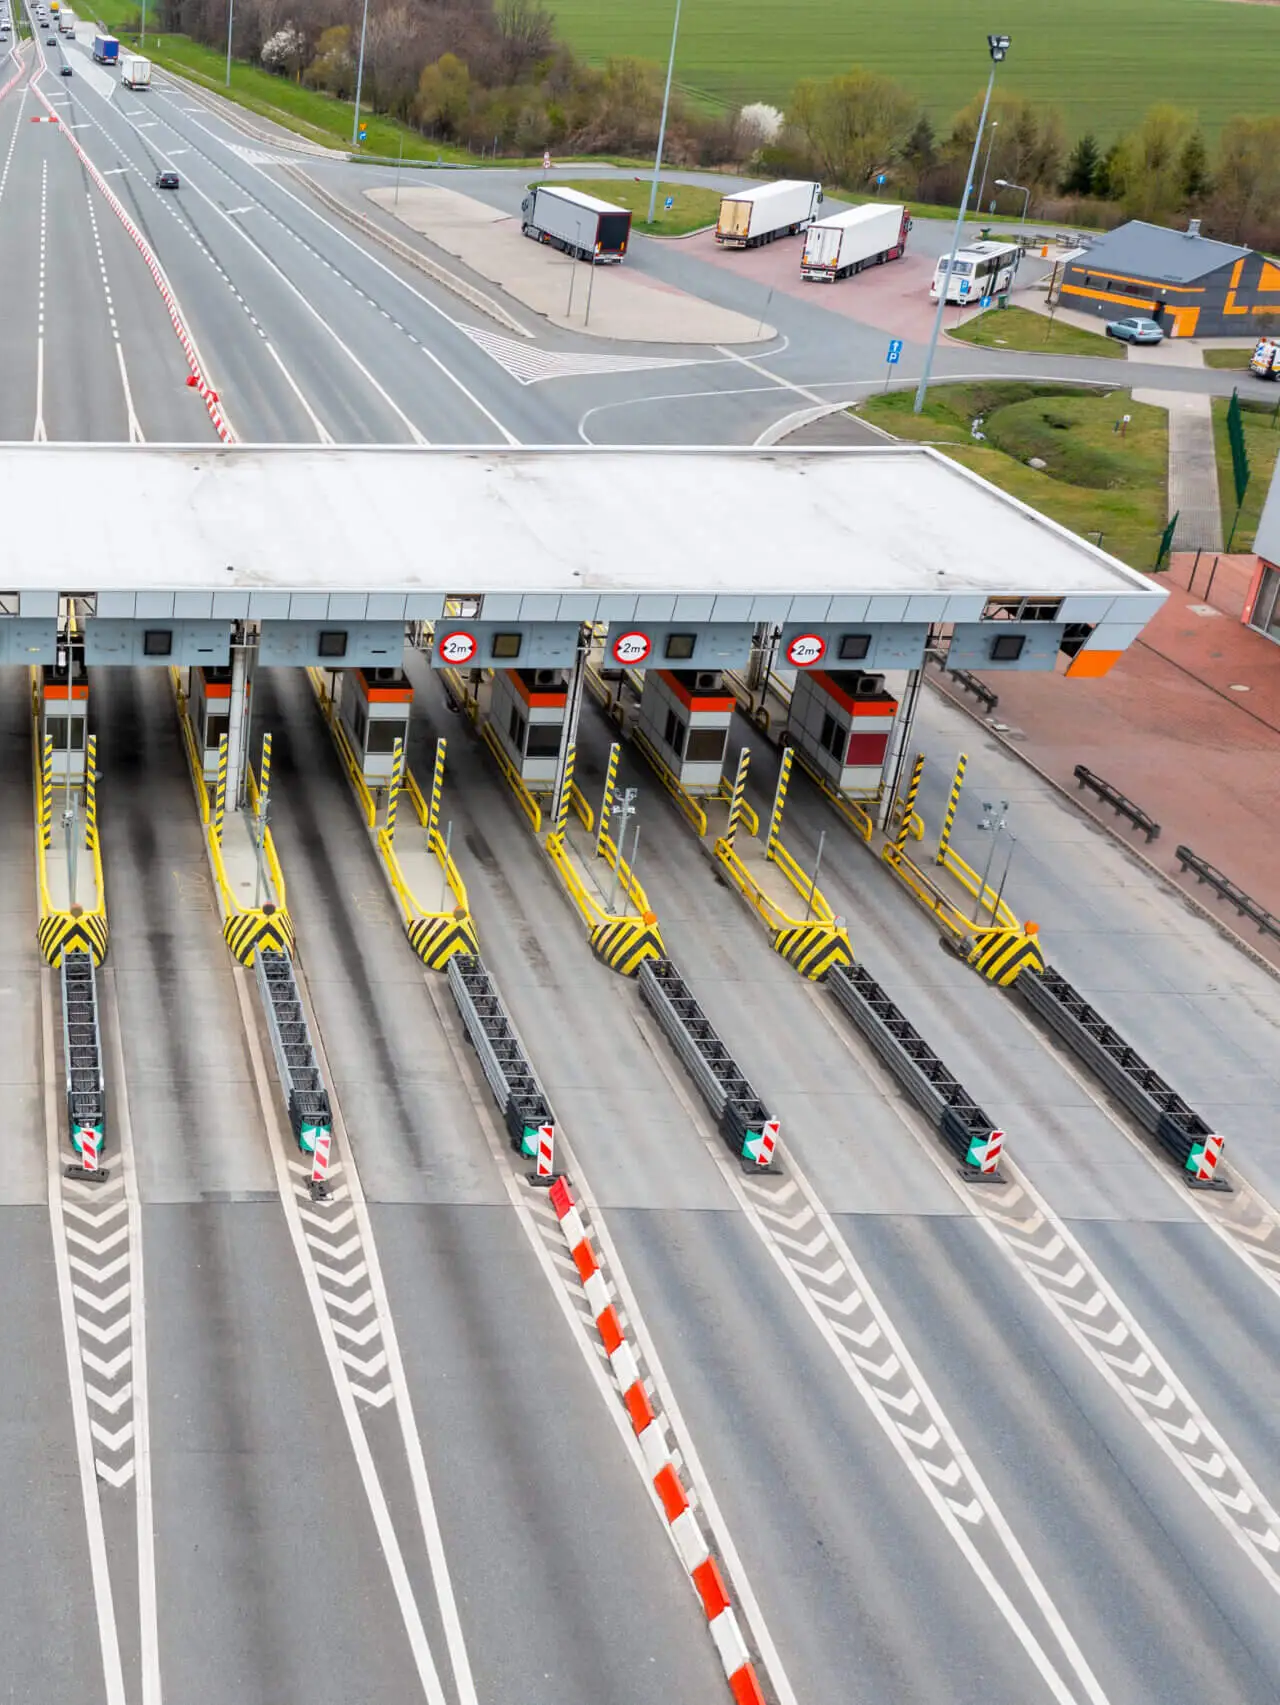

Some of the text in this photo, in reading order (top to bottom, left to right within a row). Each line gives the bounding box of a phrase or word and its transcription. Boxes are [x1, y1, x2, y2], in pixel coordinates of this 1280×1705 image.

[889, 353, 896, 361] P
[449, 643, 466, 653] 2m
[623, 643, 640, 653] 2m
[797, 645, 814, 655] 2m
